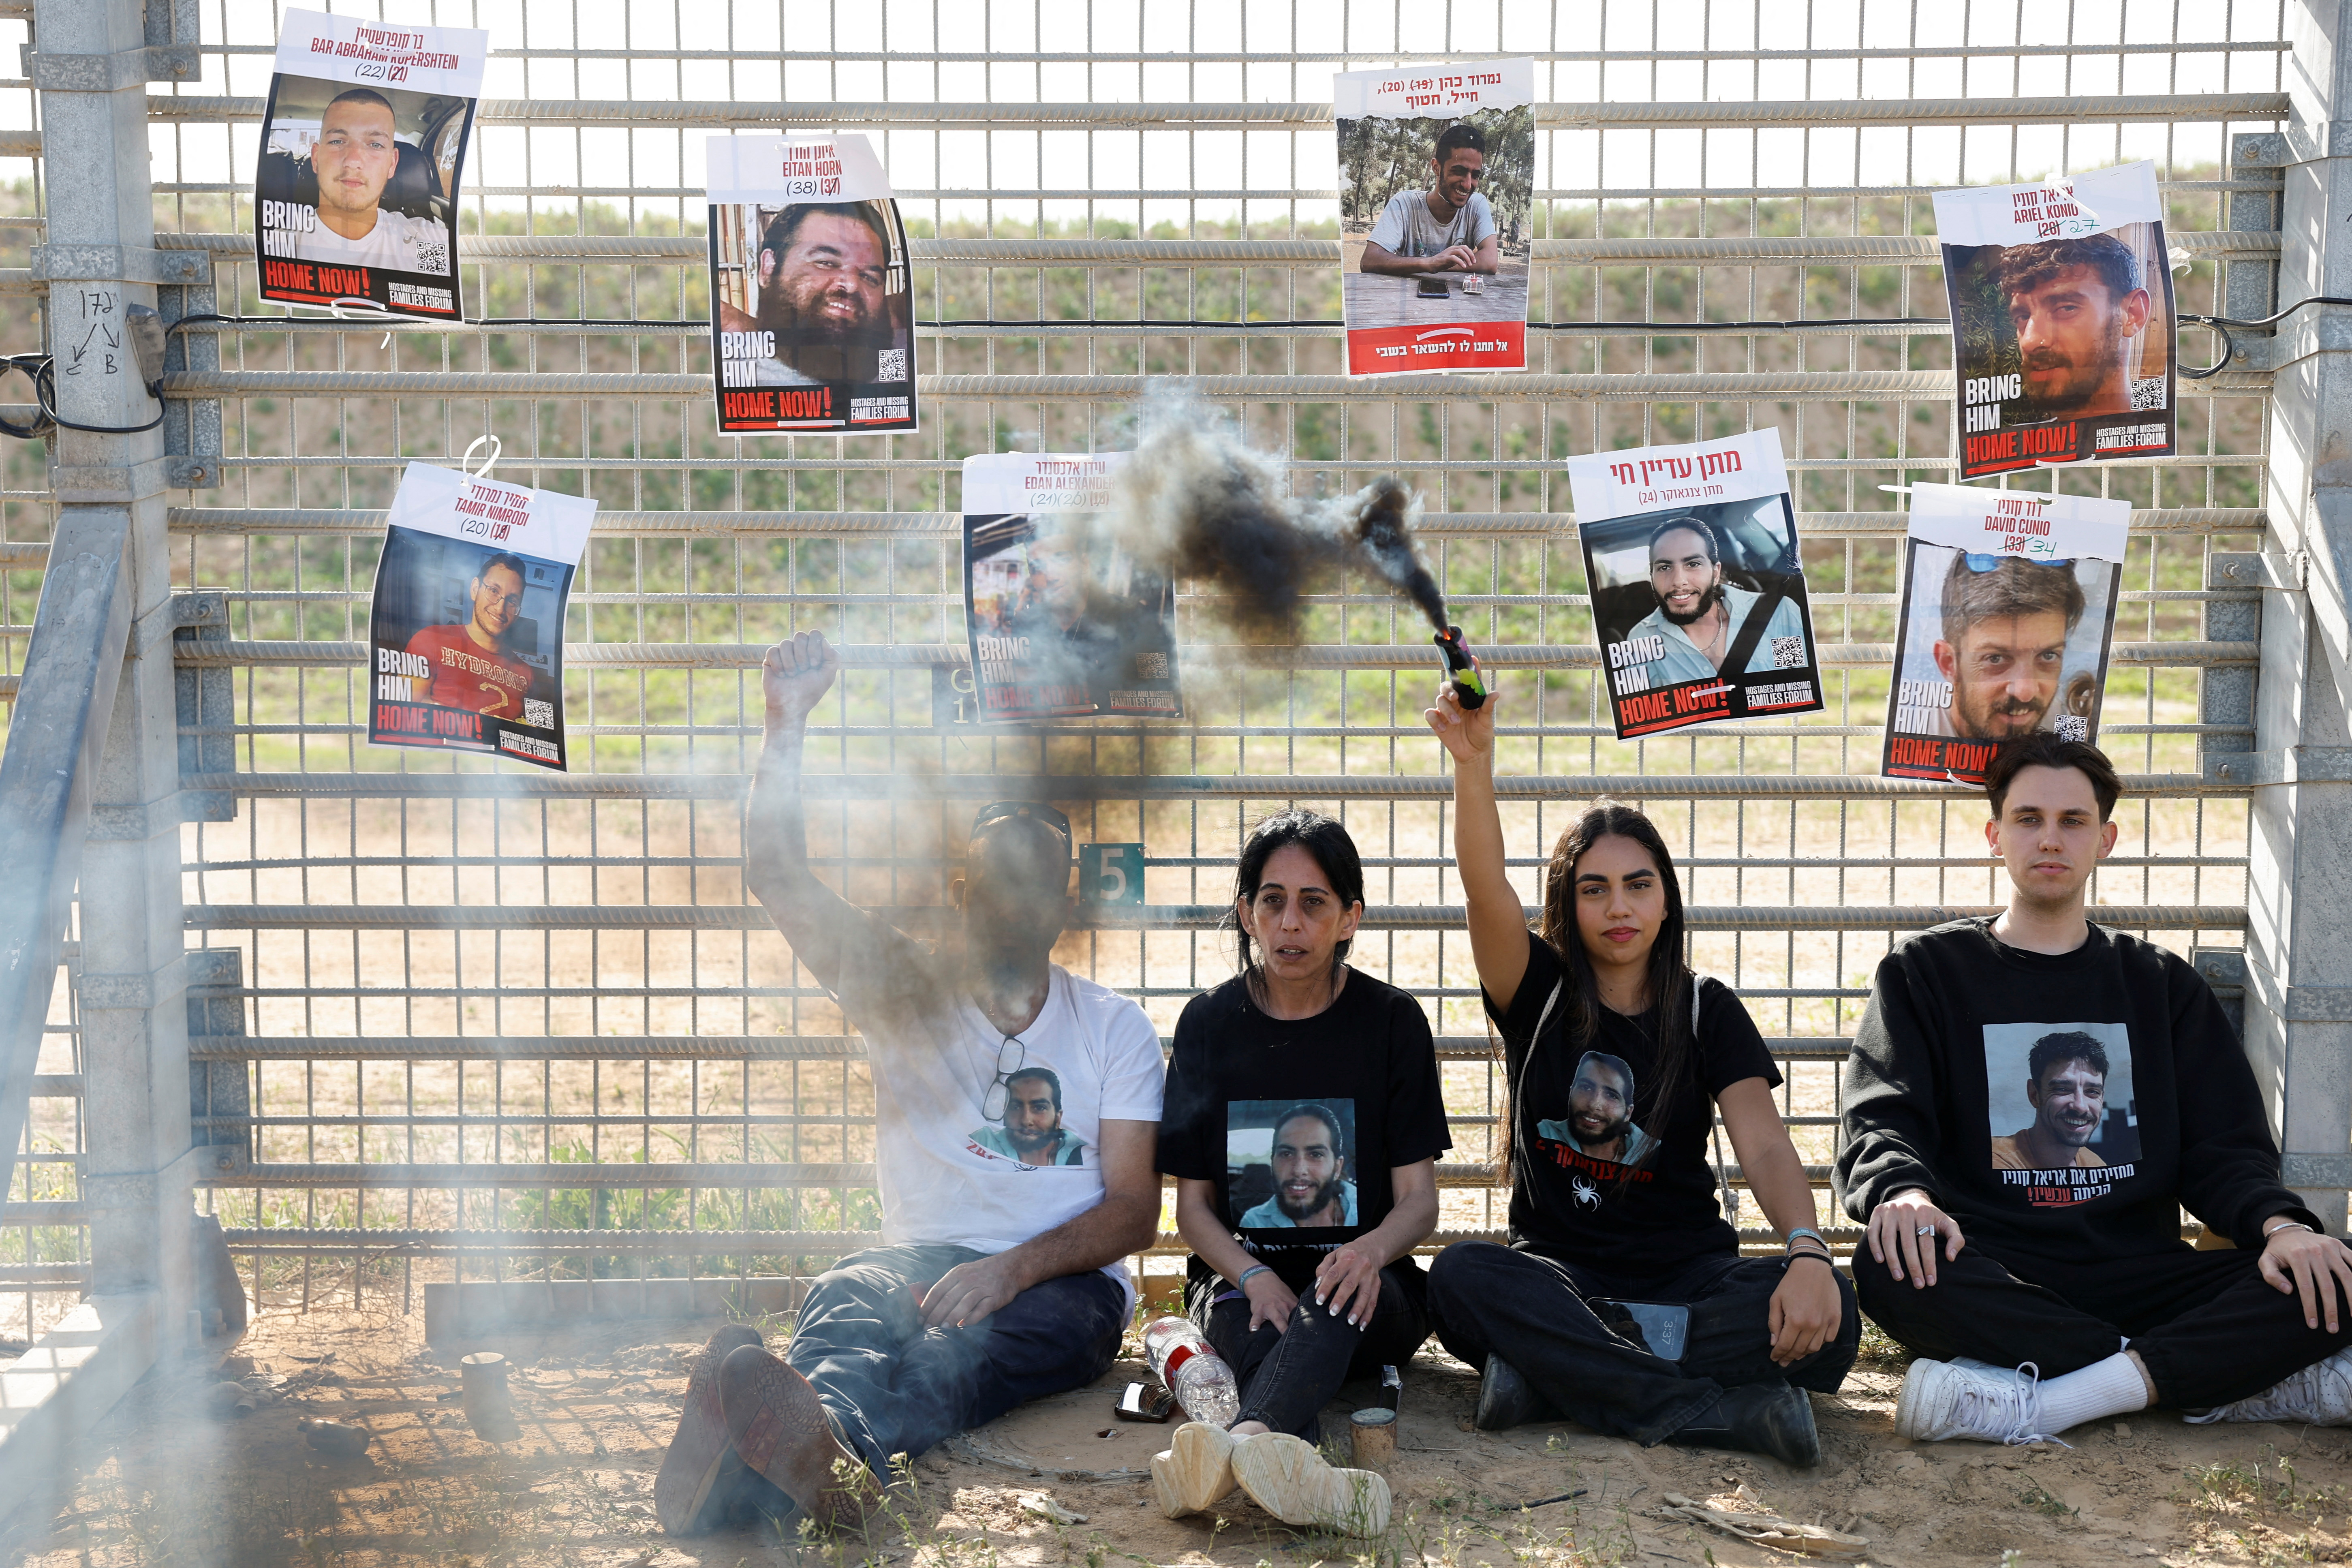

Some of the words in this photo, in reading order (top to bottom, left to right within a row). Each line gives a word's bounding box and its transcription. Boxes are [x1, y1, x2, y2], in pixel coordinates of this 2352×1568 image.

[310, 37, 334, 54] BAR
[355, 27, 410, 49] קופרשטיין
[413, 34, 423, 49] בר
[355, 63, 385, 80] (22)
[1468, 73, 1501, 86] נמרוד
[1439, 76, 1462, 92] כהן
[1406, 94, 1441, 109] חטוף
[1446, 90, 1478, 106] חייל,
[783, 162, 811, 177] EITAN
[815, 159, 842, 176] HORN
[787, 180, 817, 197] (38)
[2012, 191, 2038, 207] קוניו
[263, 200, 315, 232] BRING
[2014, 207, 2044, 224] ARIEL
[2046, 203, 2078, 219] KONIO
[2069, 219, 2100, 233] 27
[263, 229, 297, 259] HIM
[265, 261, 315, 291] HOME
[318, 267, 370, 296] NOW!
[388, 282, 416, 293] HOSTAGES
[417, 286, 427, 295] AND
[428, 287, 452, 298] MISSING
[389, 291, 424, 306] FAMILIES
[425, 295, 453, 310] FORUM
[721, 331, 775, 358] BRING
[1375, 345, 1407, 357] בשבי
[1411, 340, 1455, 354] להשאר
[1460, 340, 1470, 352] לו
[1473, 341, 1495, 352] תתנו
[1496, 339, 1507, 351] אל
[105, 354, 118, 374] B
[722, 361, 757, 387] HIM
[1965, 373, 2021, 405] BRING
[724, 391, 776, 417] HOME
[779, 387, 832, 417] NOW!
[851, 398, 875, 407] HOSTAGES
[876, 397, 886, 406] AND
[887, 396, 908, 406] MISSING
[851, 406, 883, 420] FAMILIES
[884, 405, 909, 419] FORUM
[1966, 404, 2000, 433] HIM
[2096, 426, 2125, 437] HOSTAGES
[2127, 426, 2138, 434] AND
[2140, 423, 2166, 433] MISSING
[1967, 431, 2017, 464] HOME
[2022, 421, 2077, 455] NOW!
[2096, 434, 2134, 449] FAMILIES
[2136, 432, 2166, 446] FORUM
[1035, 461, 1080, 475] אלכסנדר
[1084, 461, 1105, 477] עידן
[1610, 463, 1636, 485] חי
[1639, 458, 1692, 486] עדיין
[1697, 450, 1742, 481] מתן
[1025, 476, 1052, 490] EDAN
[1055, 476, 1116, 490] ALEXANDER
[1703, 484, 1723, 497] מתן
[471, 483, 502, 503] נמרודי
[1638, 491, 1657, 506] (24)
[1660, 488, 1701, 502] צנגאוקר
[455, 497, 487, 517] TAMIR
[486, 505, 530, 526] NIMRODI
[461, 518, 489, 537] (20)
[1984, 516, 2016, 533] DAVID
[2018, 518, 2051, 536] CUNIO
[2029, 540, 2057, 558] 34
[977, 637, 1030, 660] BRING
[1608, 635, 1664, 668] BRING
[378, 647, 429, 678] BRING
[980, 663, 1014, 683] HIM
[1614, 665, 1650, 696] HIM
[378, 674, 411, 702] HIM
[984, 687, 1035, 708] HOME
[1040, 684, 1090, 705] NOW!
[1745, 685, 1774, 695] HOSTAGES
[1775, 683, 1785, 692] AND
[1786, 681, 1811, 691] MISSING
[1898, 678, 1953, 708] BRING
[479, 682, 508, 714] 2
[1110, 697, 1145, 707] FAMILIES
[1146, 697, 1174, 708] FORUM
[1619, 691, 1672, 725] HOME
[1674, 678, 1728, 714] NOW!
[1747, 692, 1783, 707] FAMILIES
[1784, 689, 1813, 704] FORUM
[378, 705, 427, 734] HOME
[433, 709, 483, 740] NOW!
[1894, 706, 1930, 734] HIM
[499, 729, 524, 742] HOSTAGES
[525, 736, 535, 745] AND
[535, 739, 558, 751] MISSING
[500, 737, 532, 754] FAMILIES
[533, 745, 559, 762] FORUM
[1890, 738, 1941, 768] HOME
[1100, 848, 1126, 900] 5
[2002, 1170, 2029, 1187] קוניו
[2032, 1170, 2067, 1185] אריאל
[2070, 1169, 2088, 1185] את
[2089, 1164, 2134, 1184] מחזירים
[2027, 1187, 2070, 1202] עכשיו!
[2074, 1184, 2110, 1201] הביתה
[1662, 1320, 1673, 1345] 3:37
